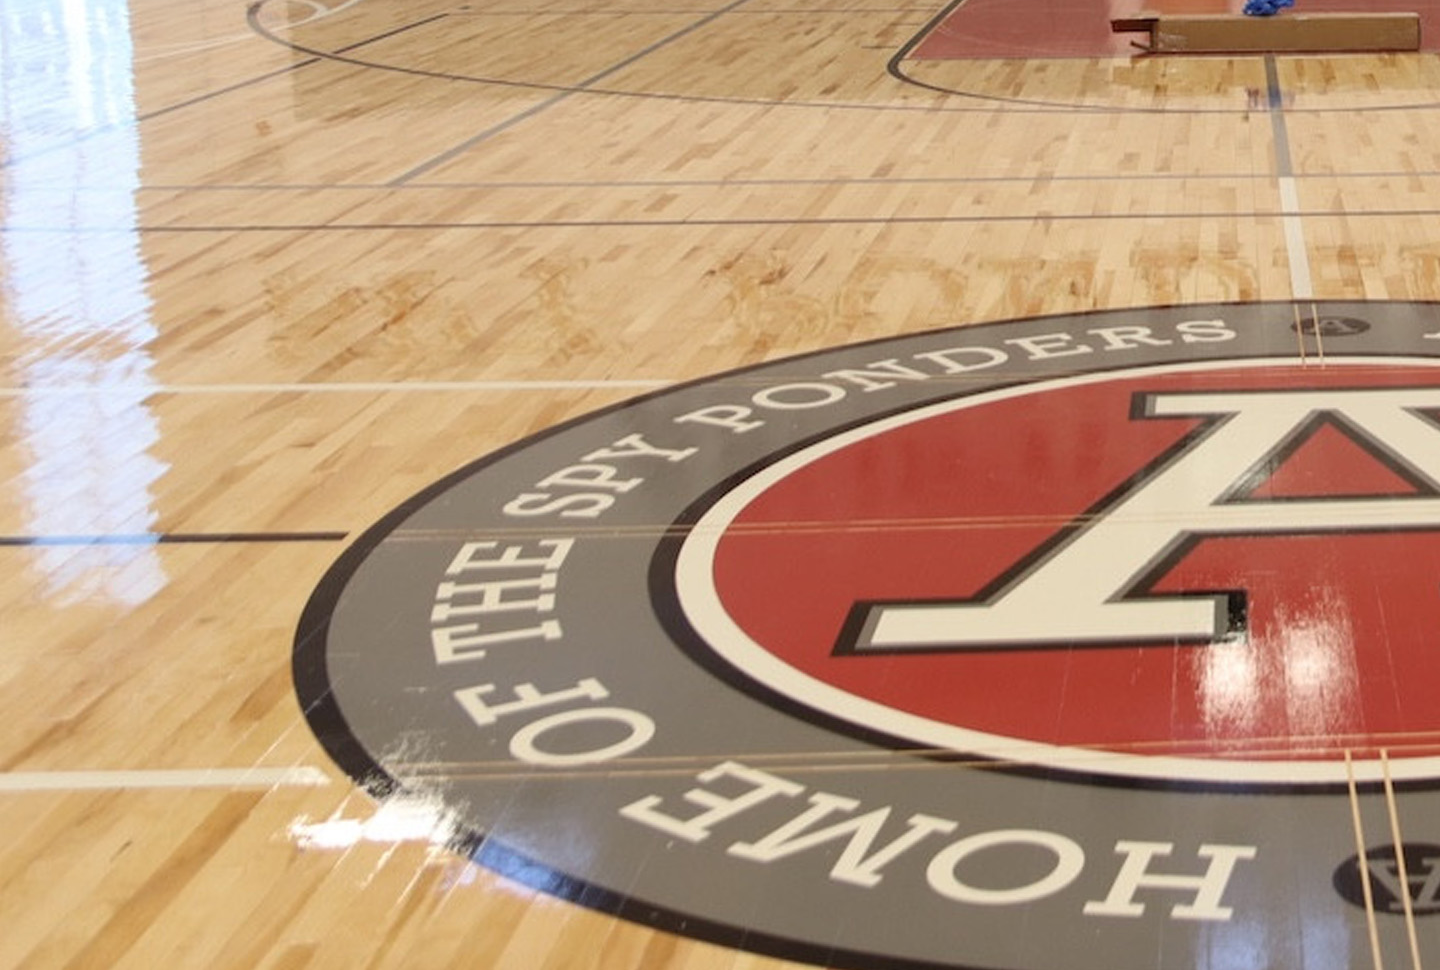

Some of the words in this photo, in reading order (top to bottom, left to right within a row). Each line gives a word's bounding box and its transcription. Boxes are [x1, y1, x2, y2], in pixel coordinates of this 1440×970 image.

[674, 316, 1239, 434] PONDERS
[502, 432, 699, 521] SPY
[430, 535, 577, 666] THE
[453, 676, 656, 767] OF
[618, 760, 1257, 921] HOME
